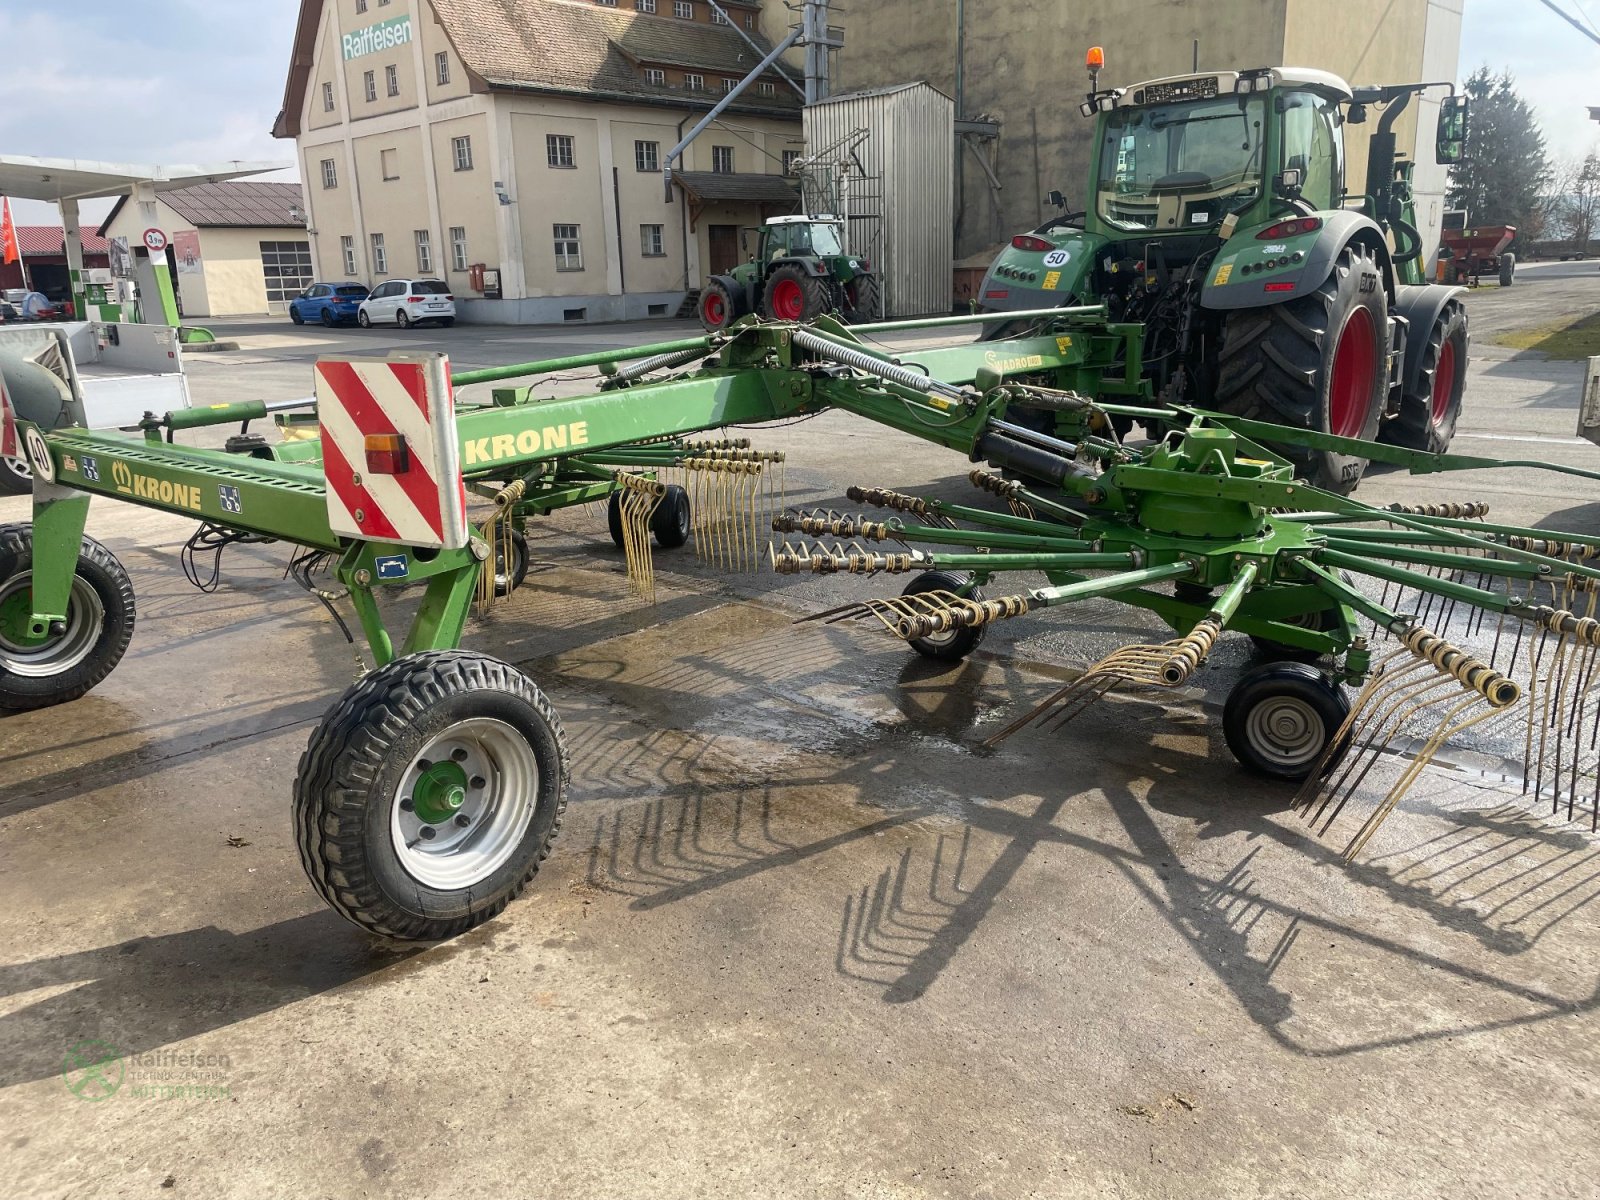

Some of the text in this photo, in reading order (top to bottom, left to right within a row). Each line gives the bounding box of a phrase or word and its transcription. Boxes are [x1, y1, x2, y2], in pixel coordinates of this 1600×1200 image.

[343, 20, 412, 60] Raiffeisen
[1047, 252, 1066, 265] 50
[28, 434, 51, 474] 40
[464, 420, 589, 465] KRONE
[133, 474, 202, 511] KRONE
